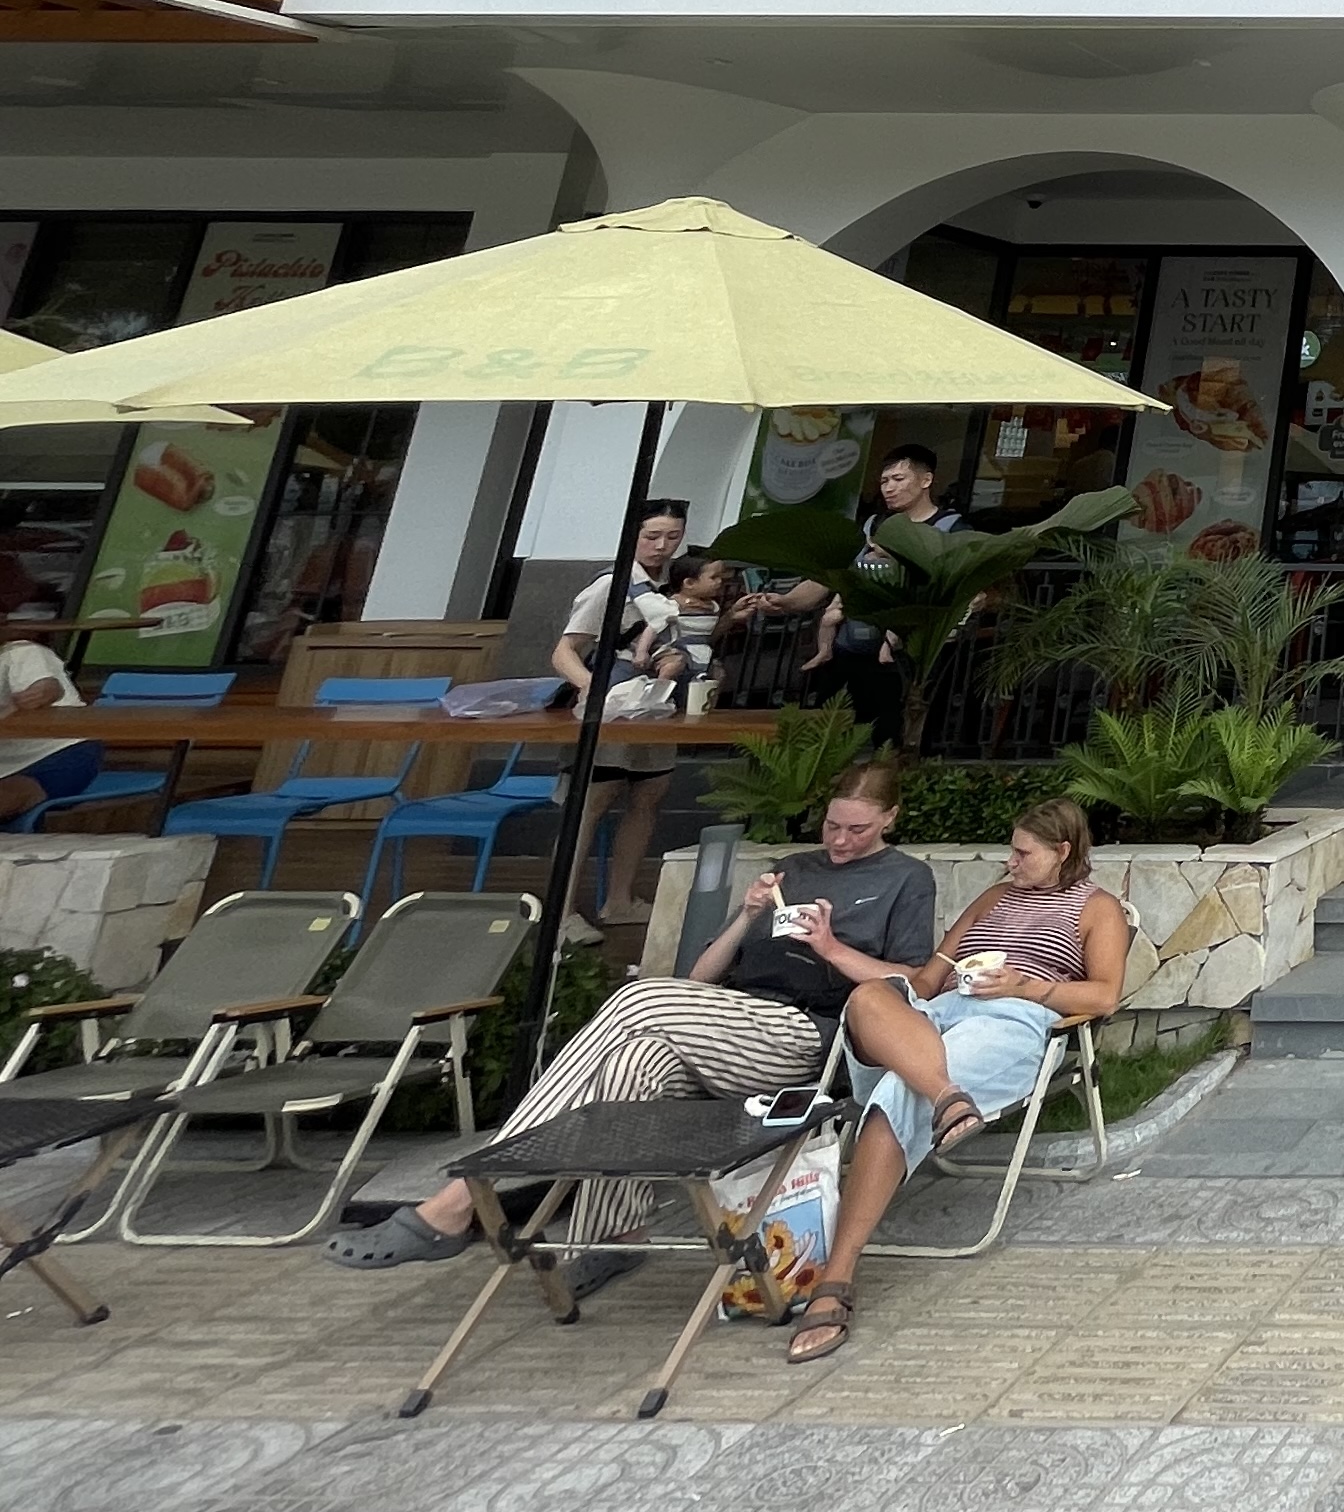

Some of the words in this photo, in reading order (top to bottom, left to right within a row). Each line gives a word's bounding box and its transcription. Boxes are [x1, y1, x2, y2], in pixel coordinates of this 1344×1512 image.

[1171, 288, 1189, 308] A
[1201, 288, 1278, 308] TASTY
[1181, 313, 1261, 333] START
